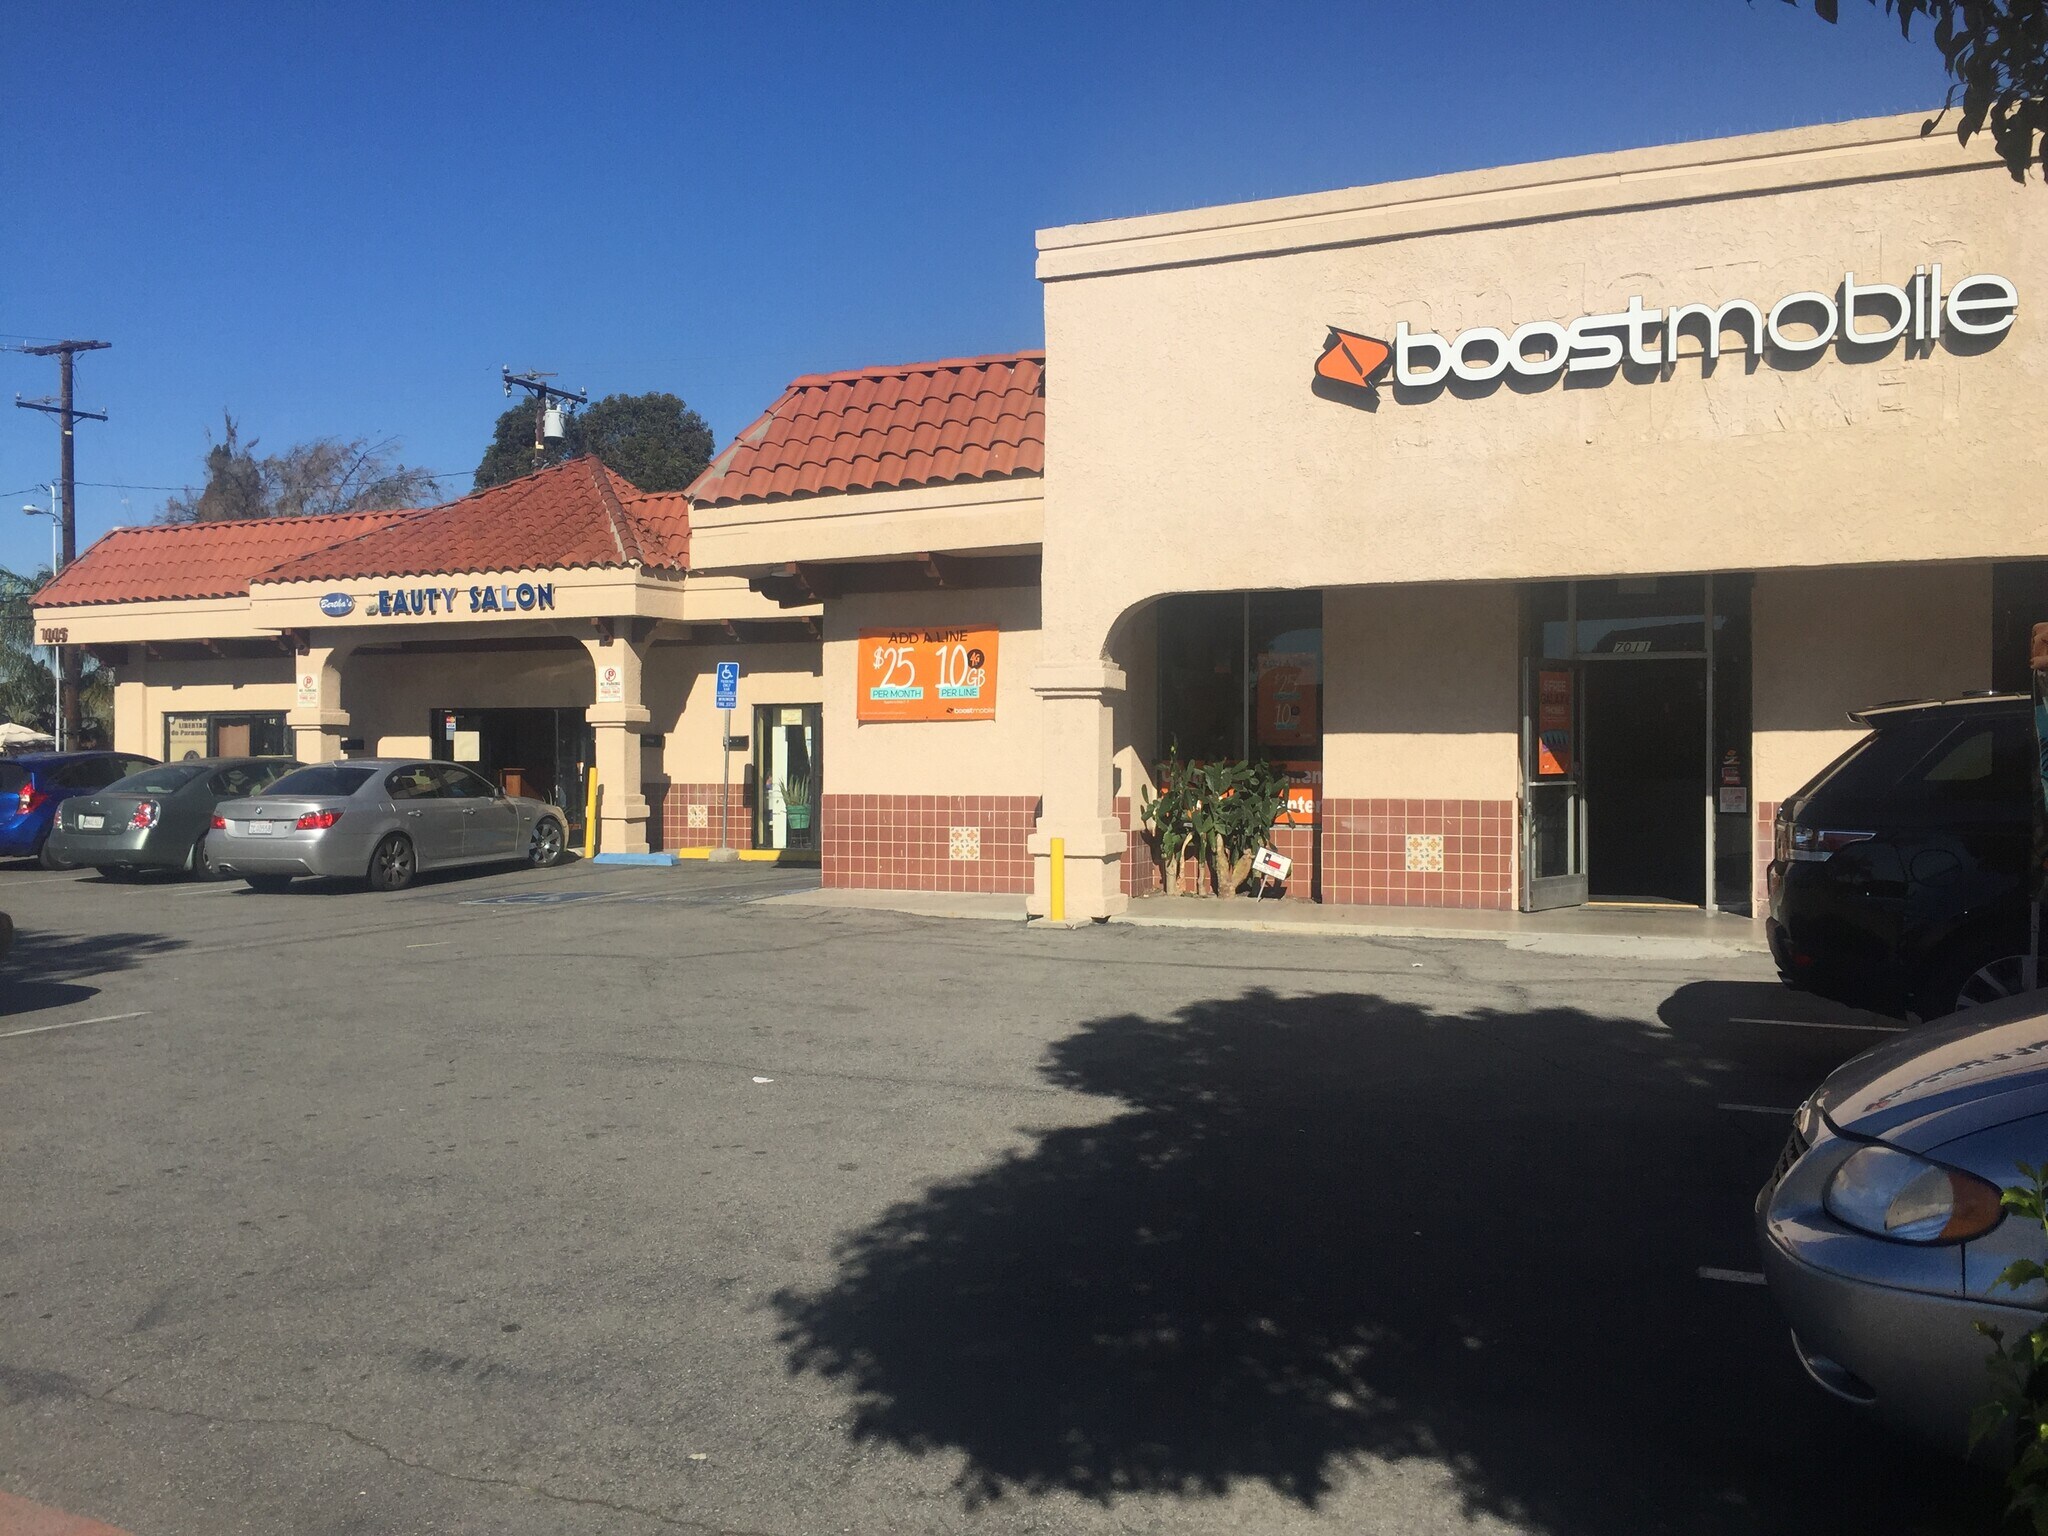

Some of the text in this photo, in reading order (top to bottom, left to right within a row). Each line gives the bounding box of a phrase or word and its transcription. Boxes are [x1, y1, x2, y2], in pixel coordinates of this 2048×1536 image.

[1396, 262, 2019, 387] boostmobile
[320, 599, 352, 608] Bertha's
[367, 583, 555, 615] EAUTY SALON
[888, 630, 968, 644] ADD A LINE
[1614, 642, 1649, 653] 7011
[873, 646, 916, 689] $25
[935, 645, 968, 689] 10
[966, 668, 986, 688] GB
[872, 688, 977, 698] PER MONTH PER LINE
